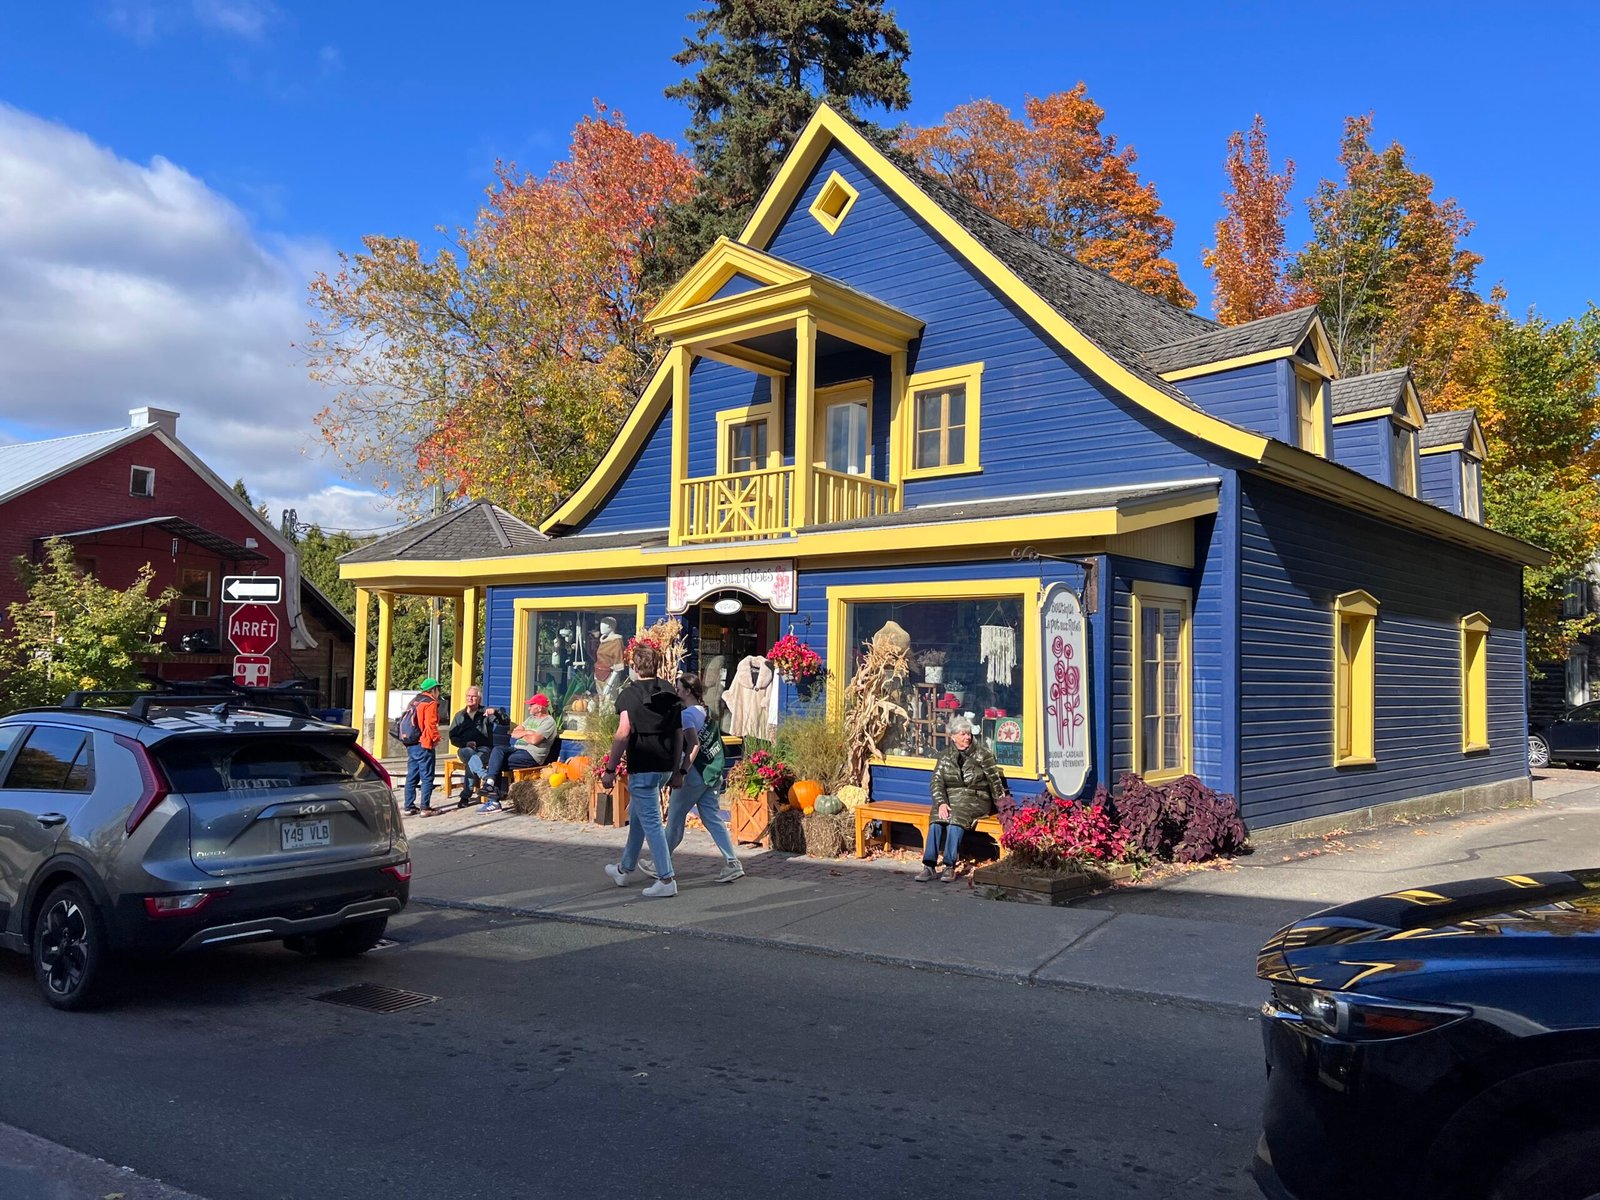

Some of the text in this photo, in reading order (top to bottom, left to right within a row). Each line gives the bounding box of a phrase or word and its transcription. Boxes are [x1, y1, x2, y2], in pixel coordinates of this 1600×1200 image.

[687, 569, 700, 587] Le
[700, 571, 722, 590] Pot
[742, 567, 774, 589] Roses
[232, 620, 276, 637] ARRÊT
[284, 825, 329, 843] Y49 VLB
